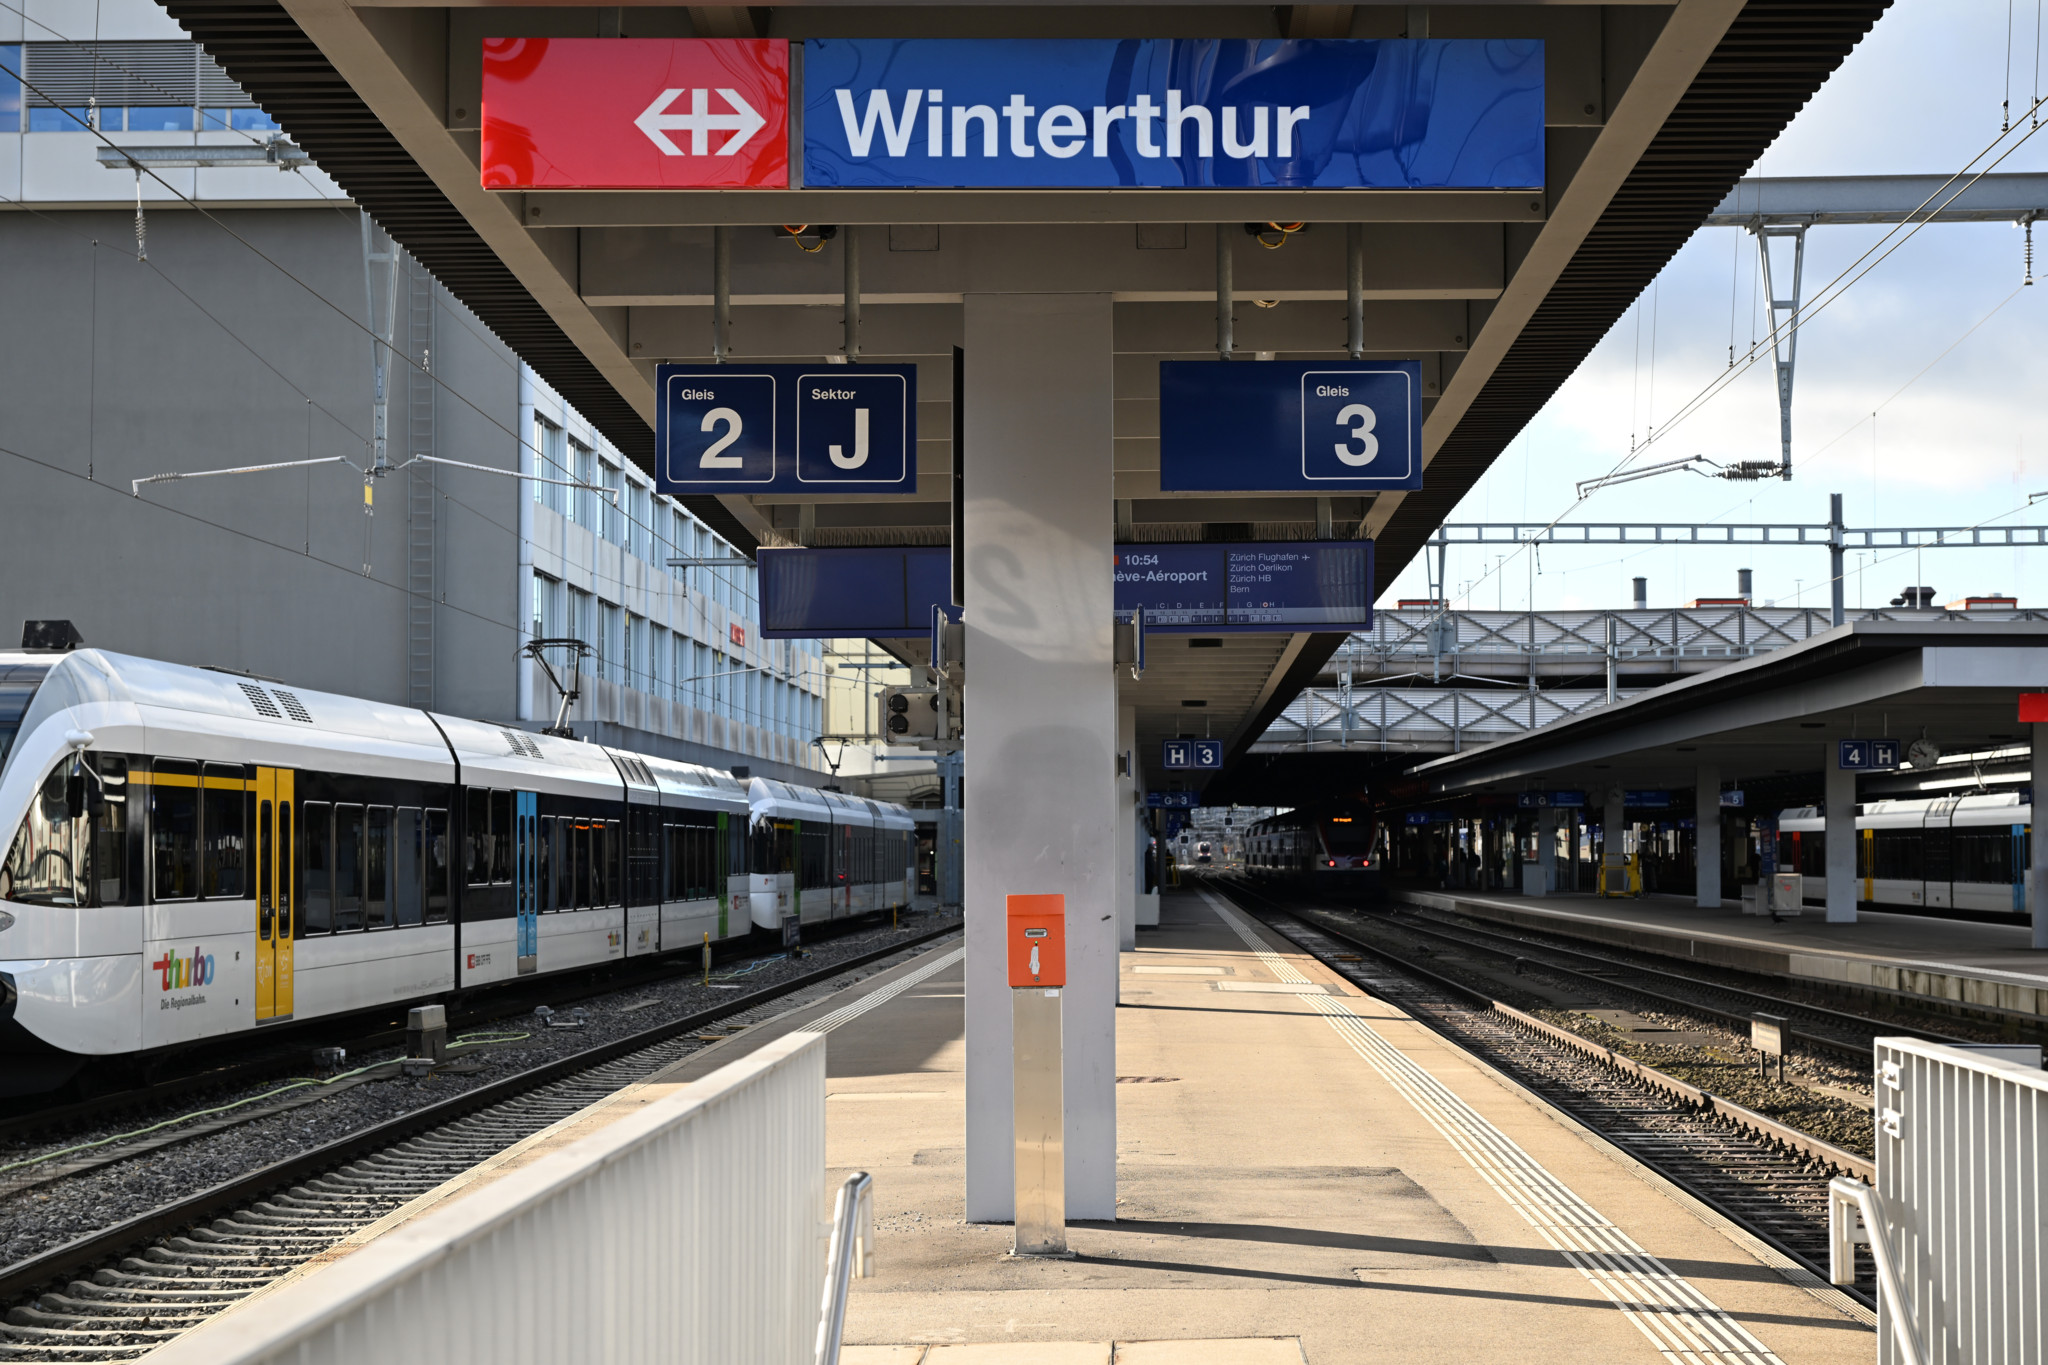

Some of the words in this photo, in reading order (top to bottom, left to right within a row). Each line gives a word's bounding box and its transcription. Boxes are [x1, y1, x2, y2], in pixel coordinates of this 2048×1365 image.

[836, 88, 1310, 159] Winterthur
[681, 388, 715, 401] Gleis
[811, 388, 856, 400] Sektor
[1315, 385, 1350, 397] Gleis
[699, 407, 743, 468] 2
[828, 408, 869, 469] J
[1334, 403, 1379, 467] 3
[1124, 554, 1159, 566] 10:54
[1230, 553, 1256, 562] Zürich
[1258, 553, 1299, 563] Flughafen
[1230, 564, 1256, 572] Zürich
[1258, 563, 1293, 572] Oerlikon
[1113, 570, 1208, 584] ève-Aéroport
[1230, 574, 1256, 583] Zürich
[1258, 574, 1272, 582] HB
[1230, 585, 1250, 593] Bern
[1171, 749, 1184, 764] H
[1202, 749, 1213, 764] 3
[1848, 749, 1861, 764] 4
[1878, 749, 1892, 764] H
[1163, 796, 1172, 805] G
[1181, 796, 1188, 805] 3
[1522, 796, 1530, 806] 4
[1537, 796, 1546, 806] G
[153, 946, 215, 992] thurbo
[160, 998, 170, 1010] Die
